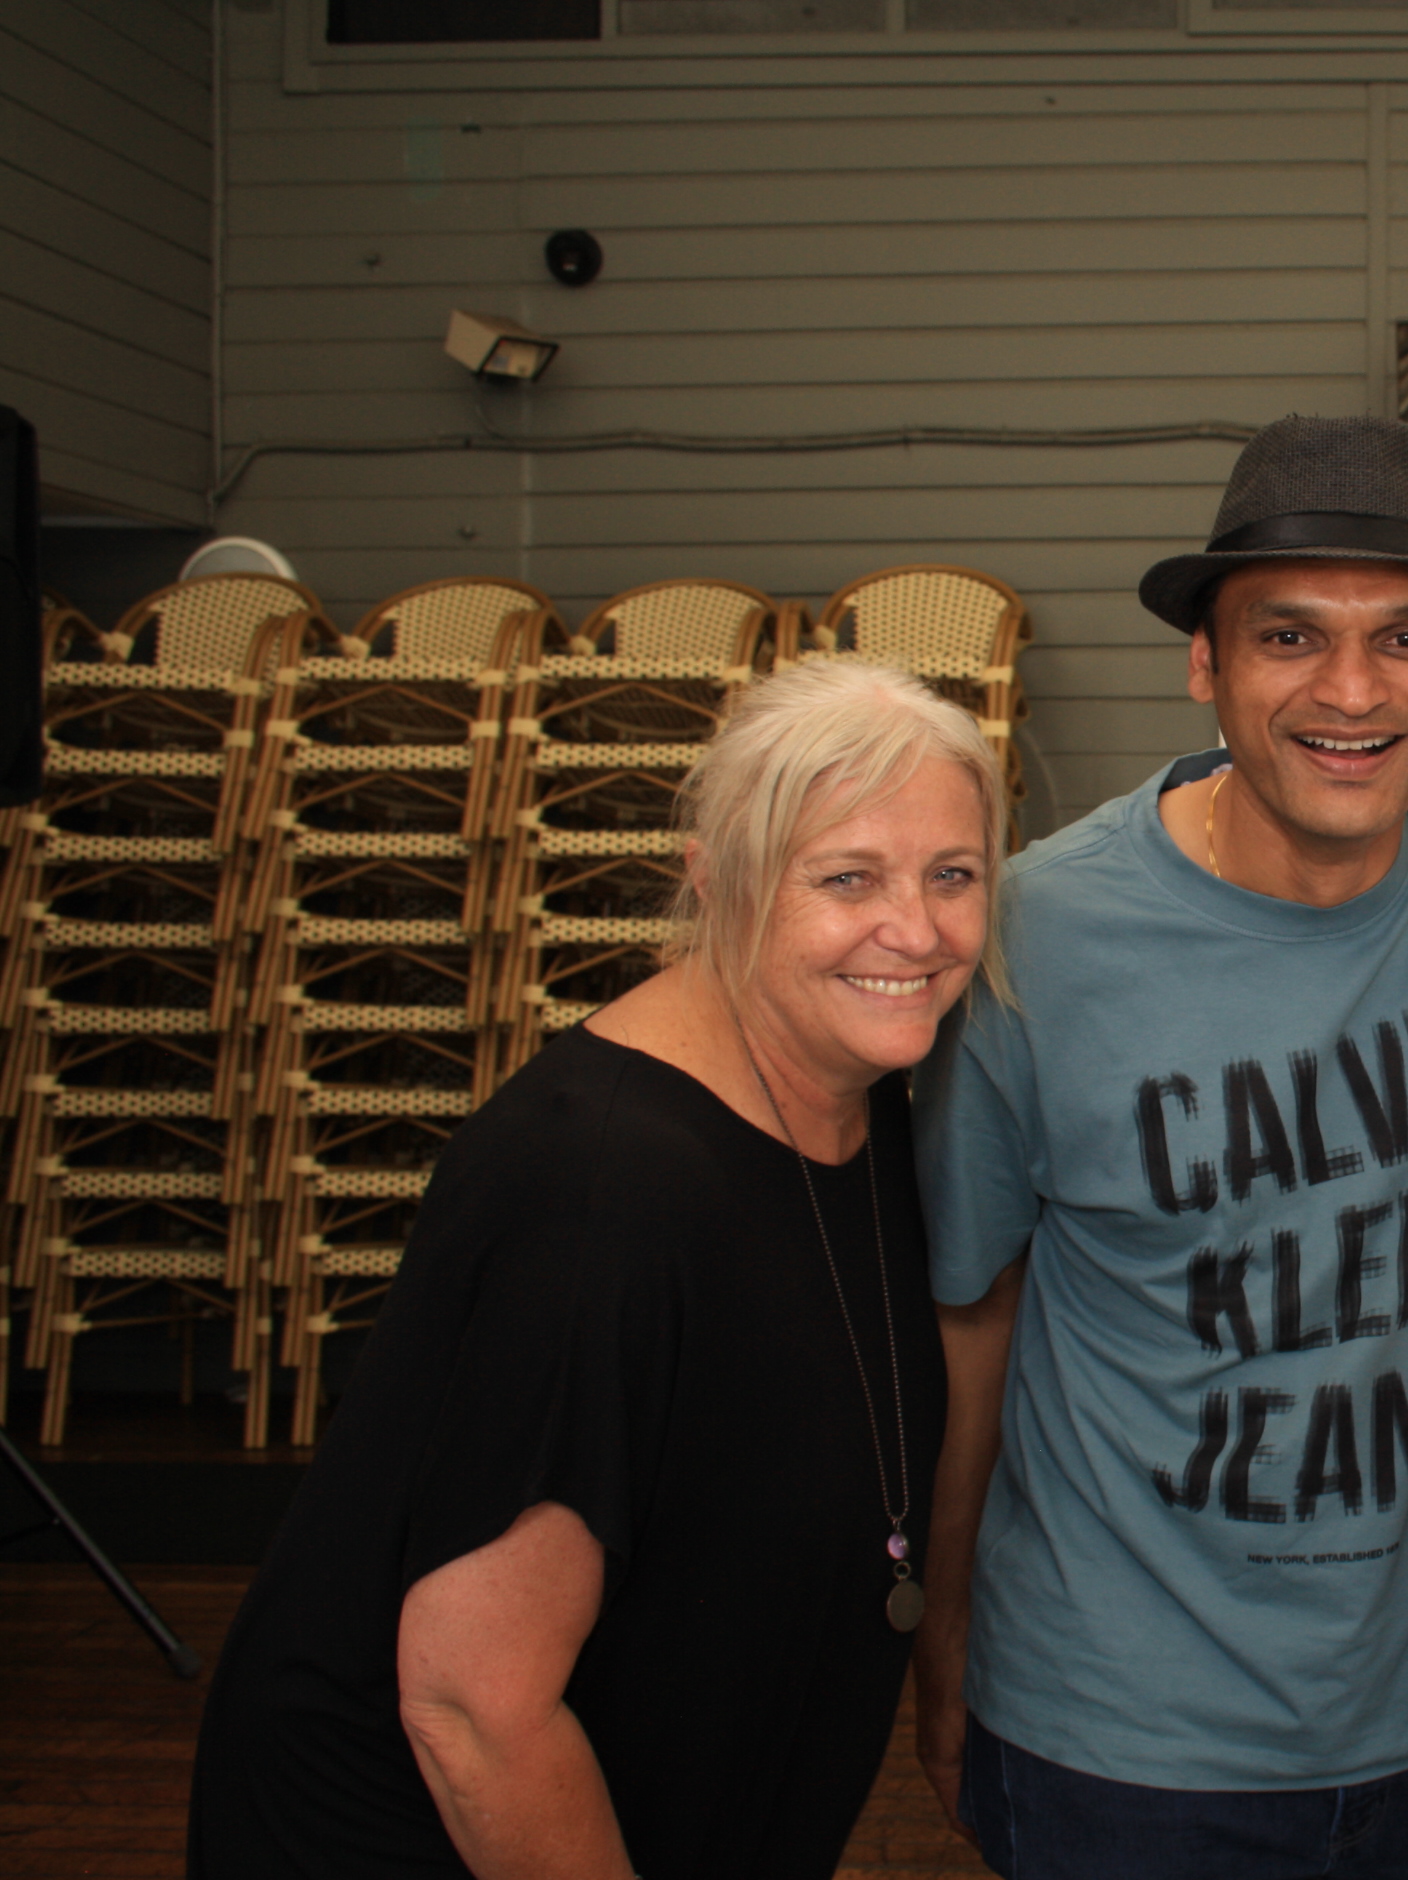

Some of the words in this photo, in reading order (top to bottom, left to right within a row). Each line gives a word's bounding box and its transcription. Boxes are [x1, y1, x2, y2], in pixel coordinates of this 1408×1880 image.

[1247, 1554, 1273, 1564] NEW
[1276, 1555, 1309, 1565] YORK,
[1313, 1548, 1383, 1564] ESTABLISHED
